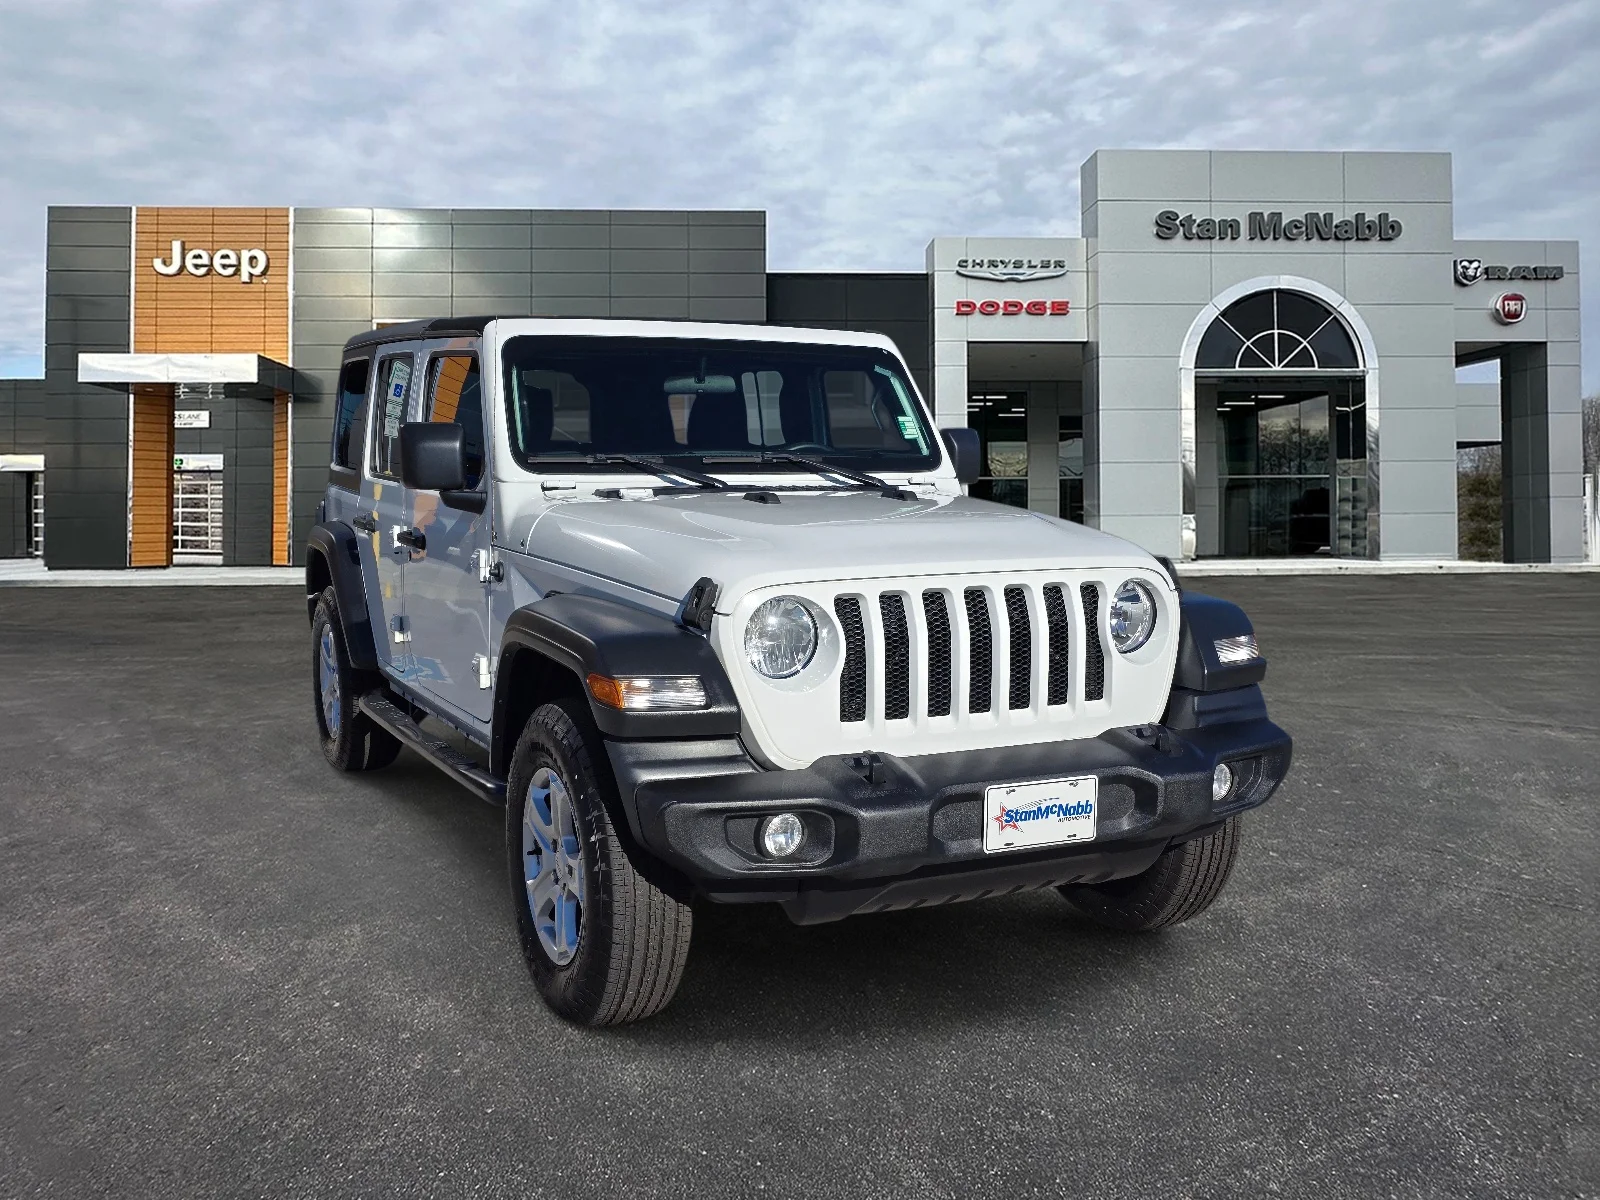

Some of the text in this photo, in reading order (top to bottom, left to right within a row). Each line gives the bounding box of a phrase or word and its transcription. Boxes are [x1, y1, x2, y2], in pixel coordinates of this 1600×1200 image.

[1155, 210, 1403, 241] Stan McNabb
[152, 239, 269, 284] Jeep
[957, 258, 1067, 269] CHRYSLER
[1483, 265, 1564, 281] RAM
[955, 300, 1070, 316] DODGE
[1057, 815, 1092, 823] AUTOMOTIVE
